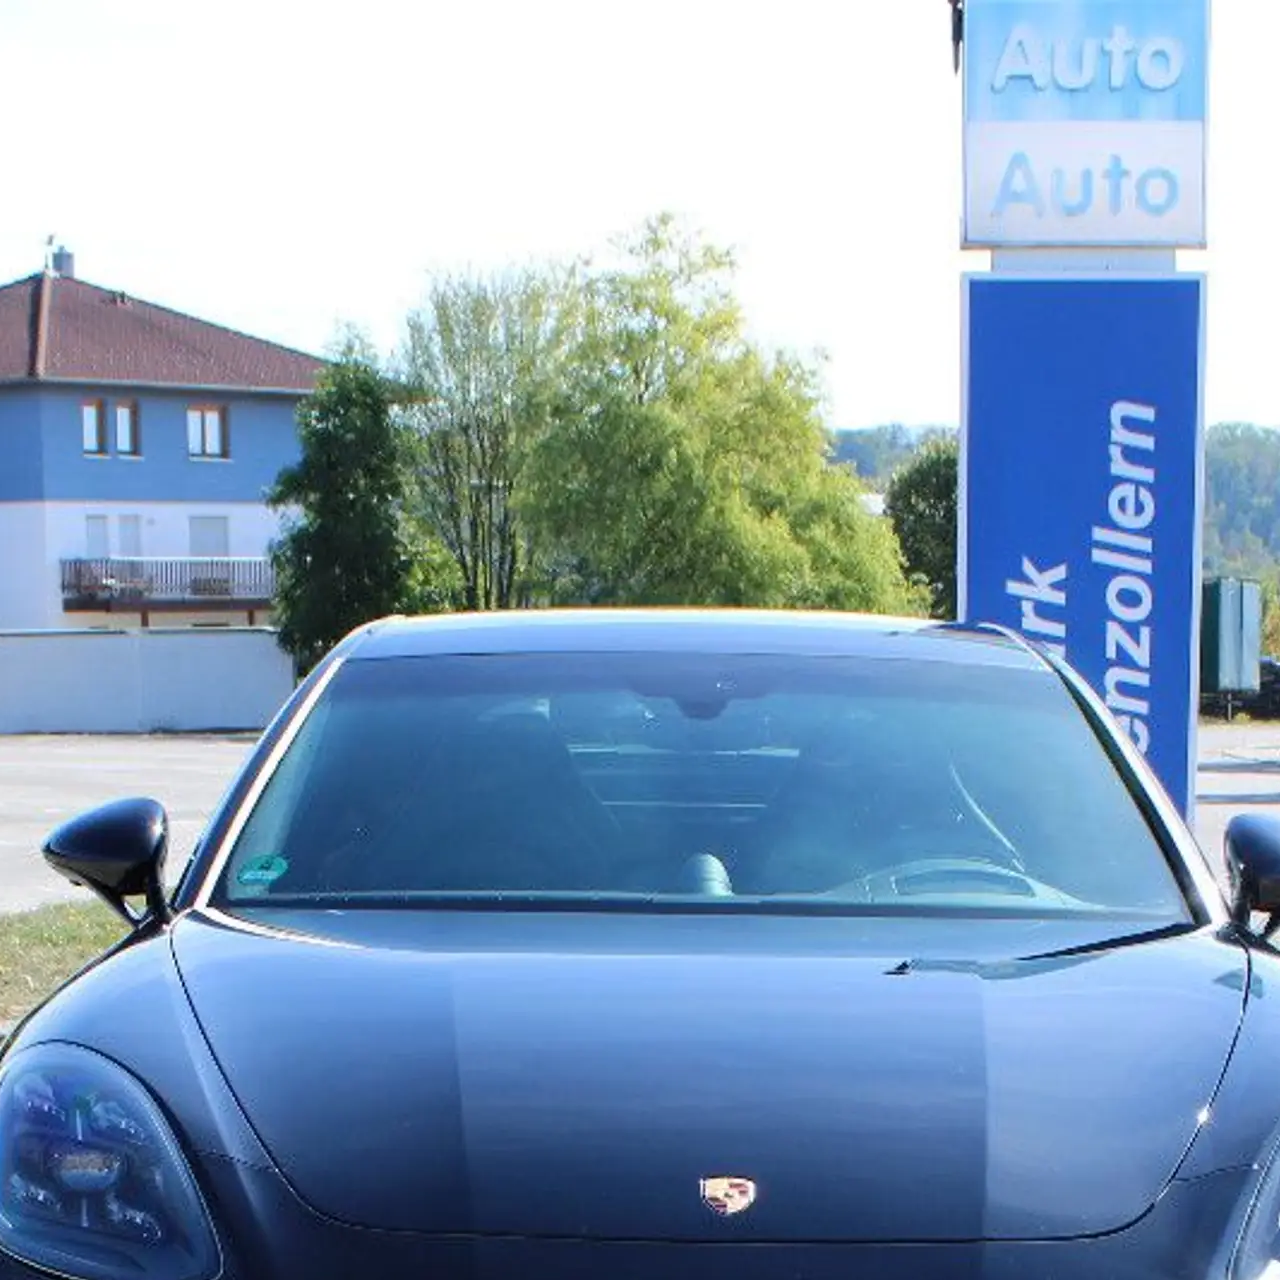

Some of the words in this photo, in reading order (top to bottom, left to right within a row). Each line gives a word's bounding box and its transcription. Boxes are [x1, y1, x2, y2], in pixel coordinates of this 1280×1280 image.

[990, 23, 1184, 94] Auto
[990, 150, 1180, 218] Auto
[1005, 555, 1067, 660] rk
